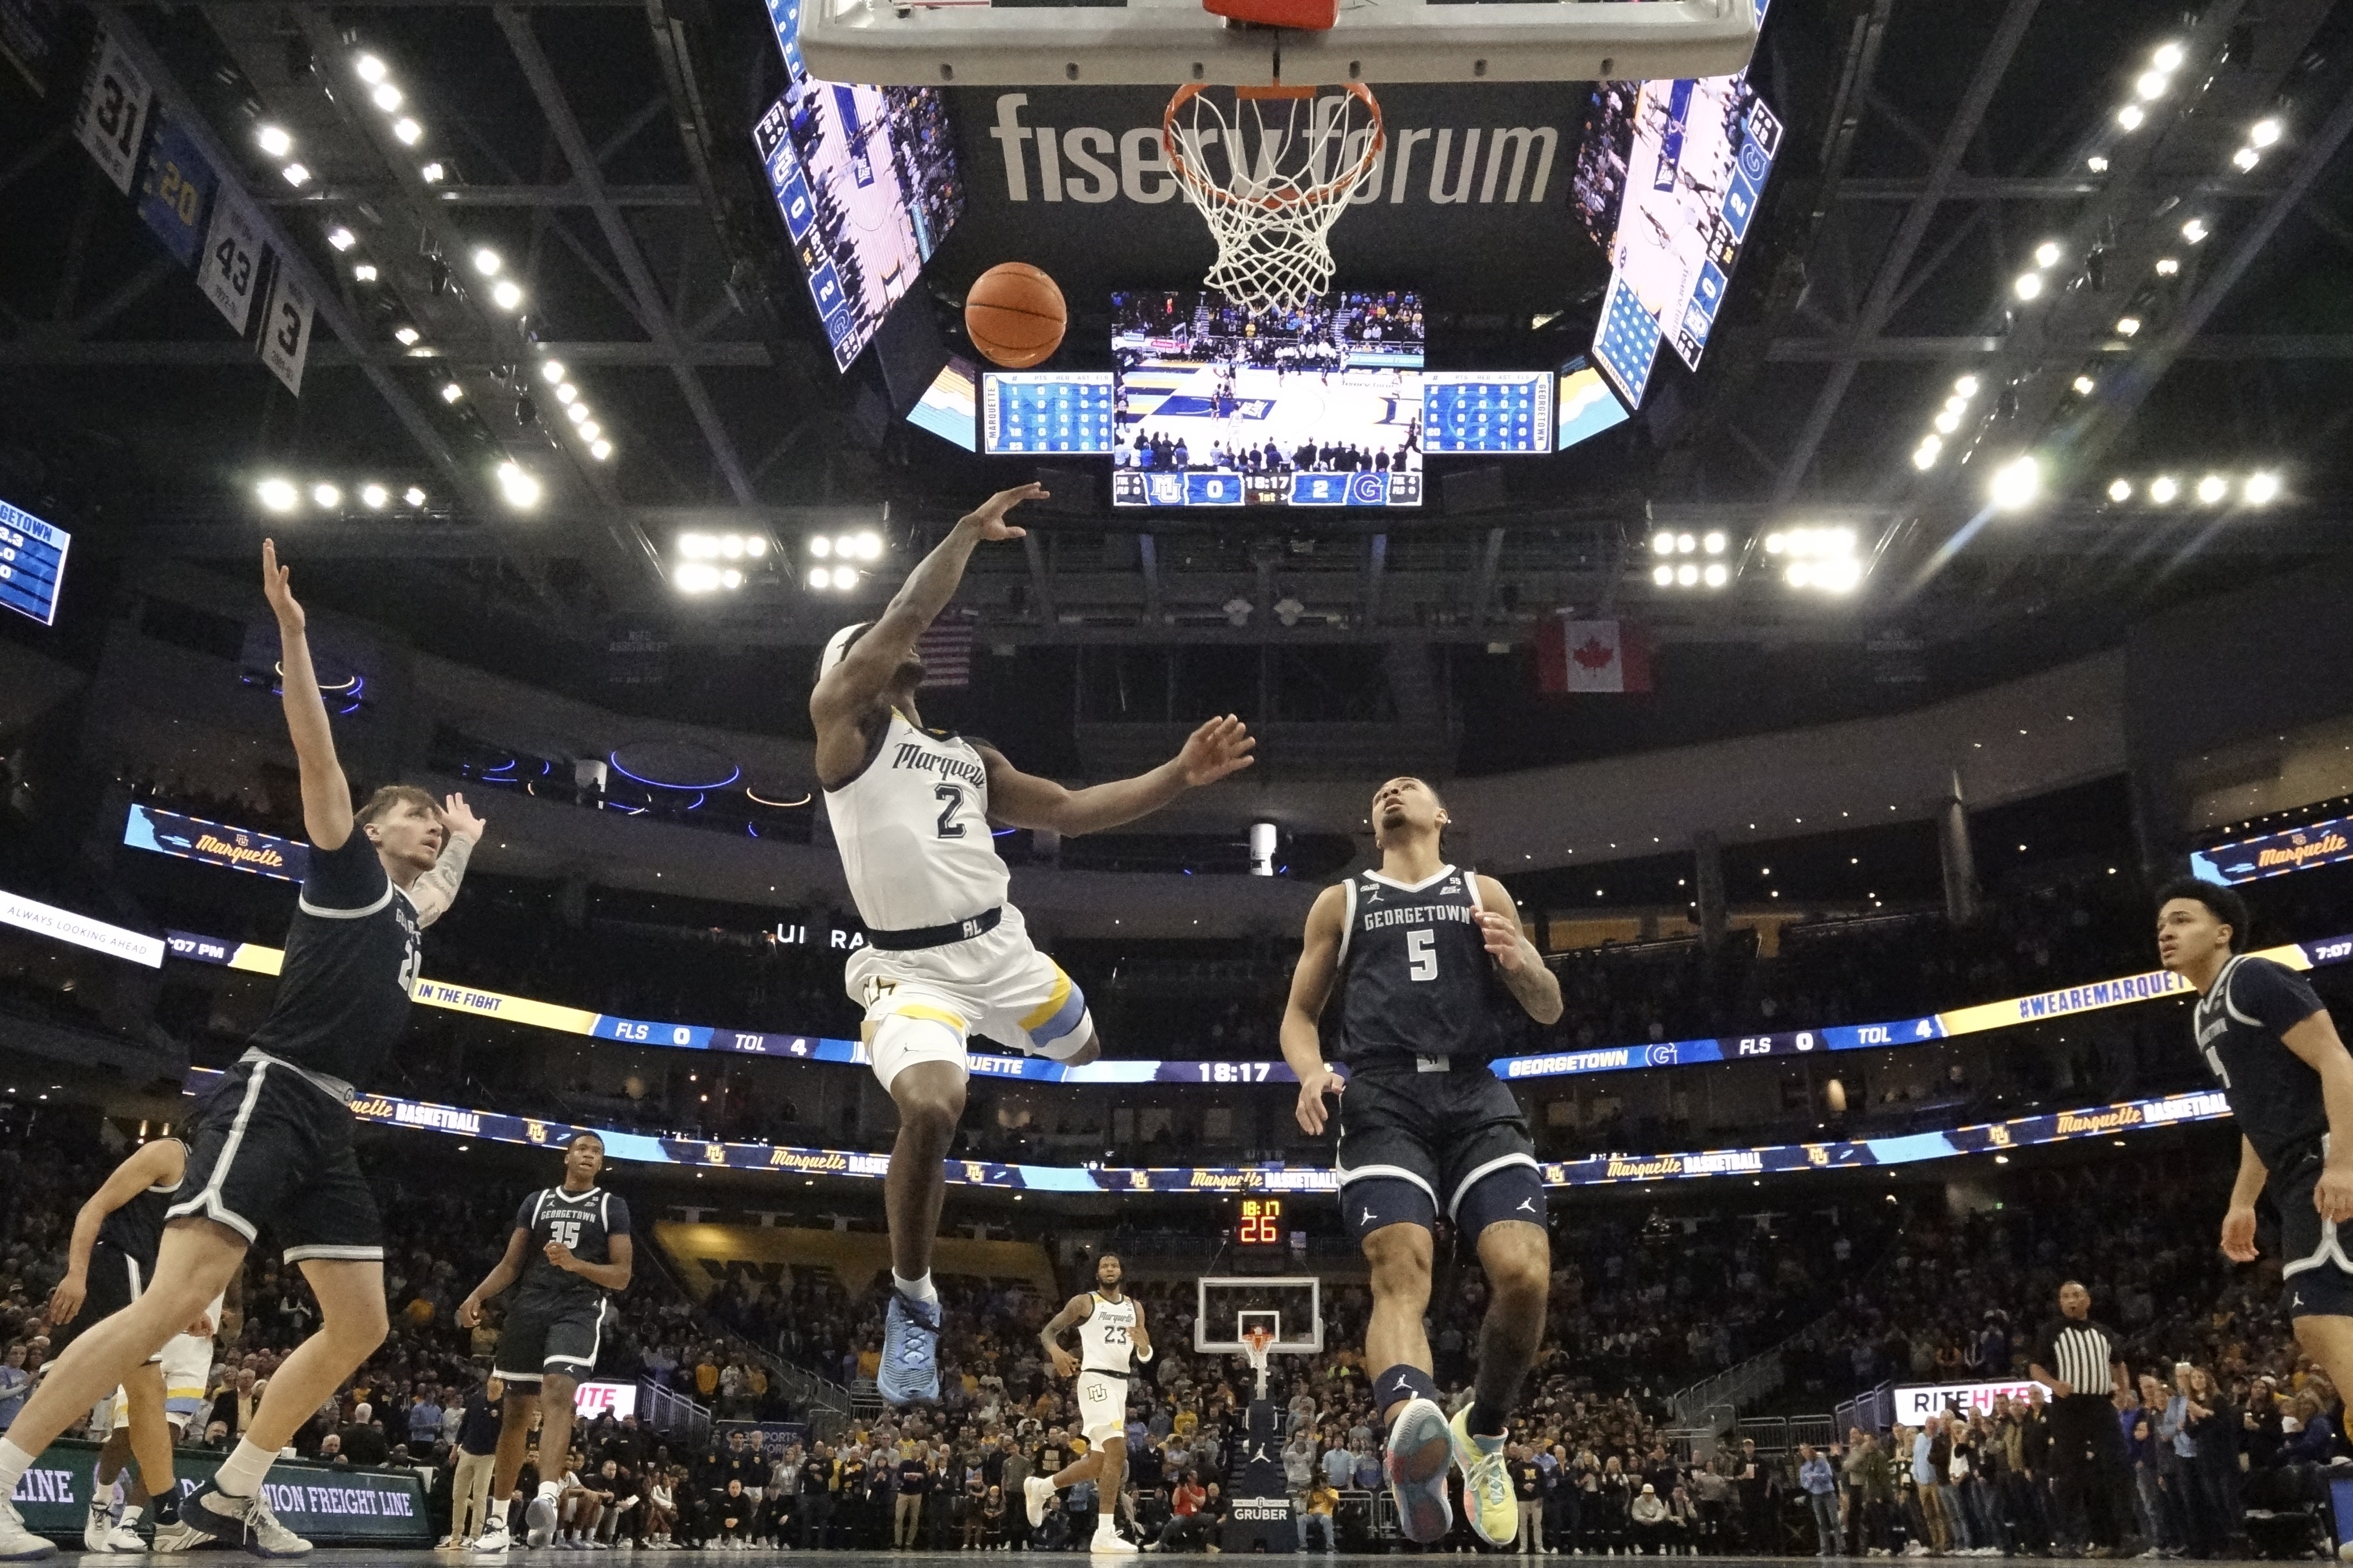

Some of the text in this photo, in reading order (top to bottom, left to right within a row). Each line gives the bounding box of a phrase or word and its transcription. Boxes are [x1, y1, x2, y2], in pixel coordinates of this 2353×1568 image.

[97, 74, 137, 157] 31
[991, 92, 1559, 204] fiserv forum
[160, 161, 197, 226] 20
[1730, 193, 1746, 217] 2
[791, 196, 805, 219] 0
[808, 223, 828, 262] 18:17
[216, 237, 251, 296] 43
[820, 280, 834, 301] 2
[1702, 277, 1716, 299] 0
[278, 302, 301, 356] 3
[1537, 384, 1546, 441] GEORGETOWN
[1151, 475, 1182, 503] MU
[1207, 480, 1223, 498] 0
[1245, 476, 1289, 489] 18:17
[1312, 480, 1328, 498] 2
[1354, 474, 1383, 503] G
[1258, 492, 1275, 502] 1st
[934, 782, 967, 839] 2
[196, 834, 283, 867] Marquette
[2258, 835, 2347, 867] Marquette
[962, 920, 982, 939] AL
[1365, 905, 1470, 931] GEORGETOWN
[8, 906, 147, 956] ALWAYS LOOKING AHEAD
[777, 923, 805, 944] UI
[199, 943, 224, 959] PM
[1406, 928, 1438, 981] 5
[2315, 942, 2352, 960] 7:07
[417, 984, 502, 1011] IN THE FIGHT
[615, 1022, 690, 1045] FLS 0
[1739, 1032, 1813, 1055] FLS 0
[1858, 1020, 1932, 1044] TOL 4
[735, 1034, 807, 1056] TOL 4
[1199, 1063, 1270, 1082] 18:17
[1509, 1050, 1629, 1077] GEORGETOWN
[349, 1099, 480, 1133] uette BASKETBALL
[2057, 1106, 2143, 1134] Marquette
[527, 1121, 548, 1143] MU
[1990, 1126, 2011, 1145] MU
[705, 1143, 726, 1164] MU
[770, 1149, 890, 1175] Marquette BASKE
[1808, 1146, 1830, 1165] MU
[966, 1163, 984, 1183] MU
[1546, 1164, 1565, 1184] MU
[1607, 1152, 1763, 1179] Marquette BASKETBALL
[1130, 1171, 1149, 1189] MU
[1191, 1171, 1339, 1190] Marquette BASKETBALL
[541, 1210, 596, 1223] GEORGETOWN
[1243, 1201, 1279, 1216] 18:17
[549, 1221, 581, 1249] 35
[1241, 1216, 1276, 1242] 26
[1098, 1311, 1134, 1323] Marquette
[1104, 1326, 1126, 1345] 23
[574, 1387, 616, 1408] ITE
[1087, 1384, 1107, 1403] MU
[306, 1486, 378, 1516] FREIGHT
[379, 1491, 413, 1517] LINE
[1235, 1508, 1287, 1520] GRUBER
